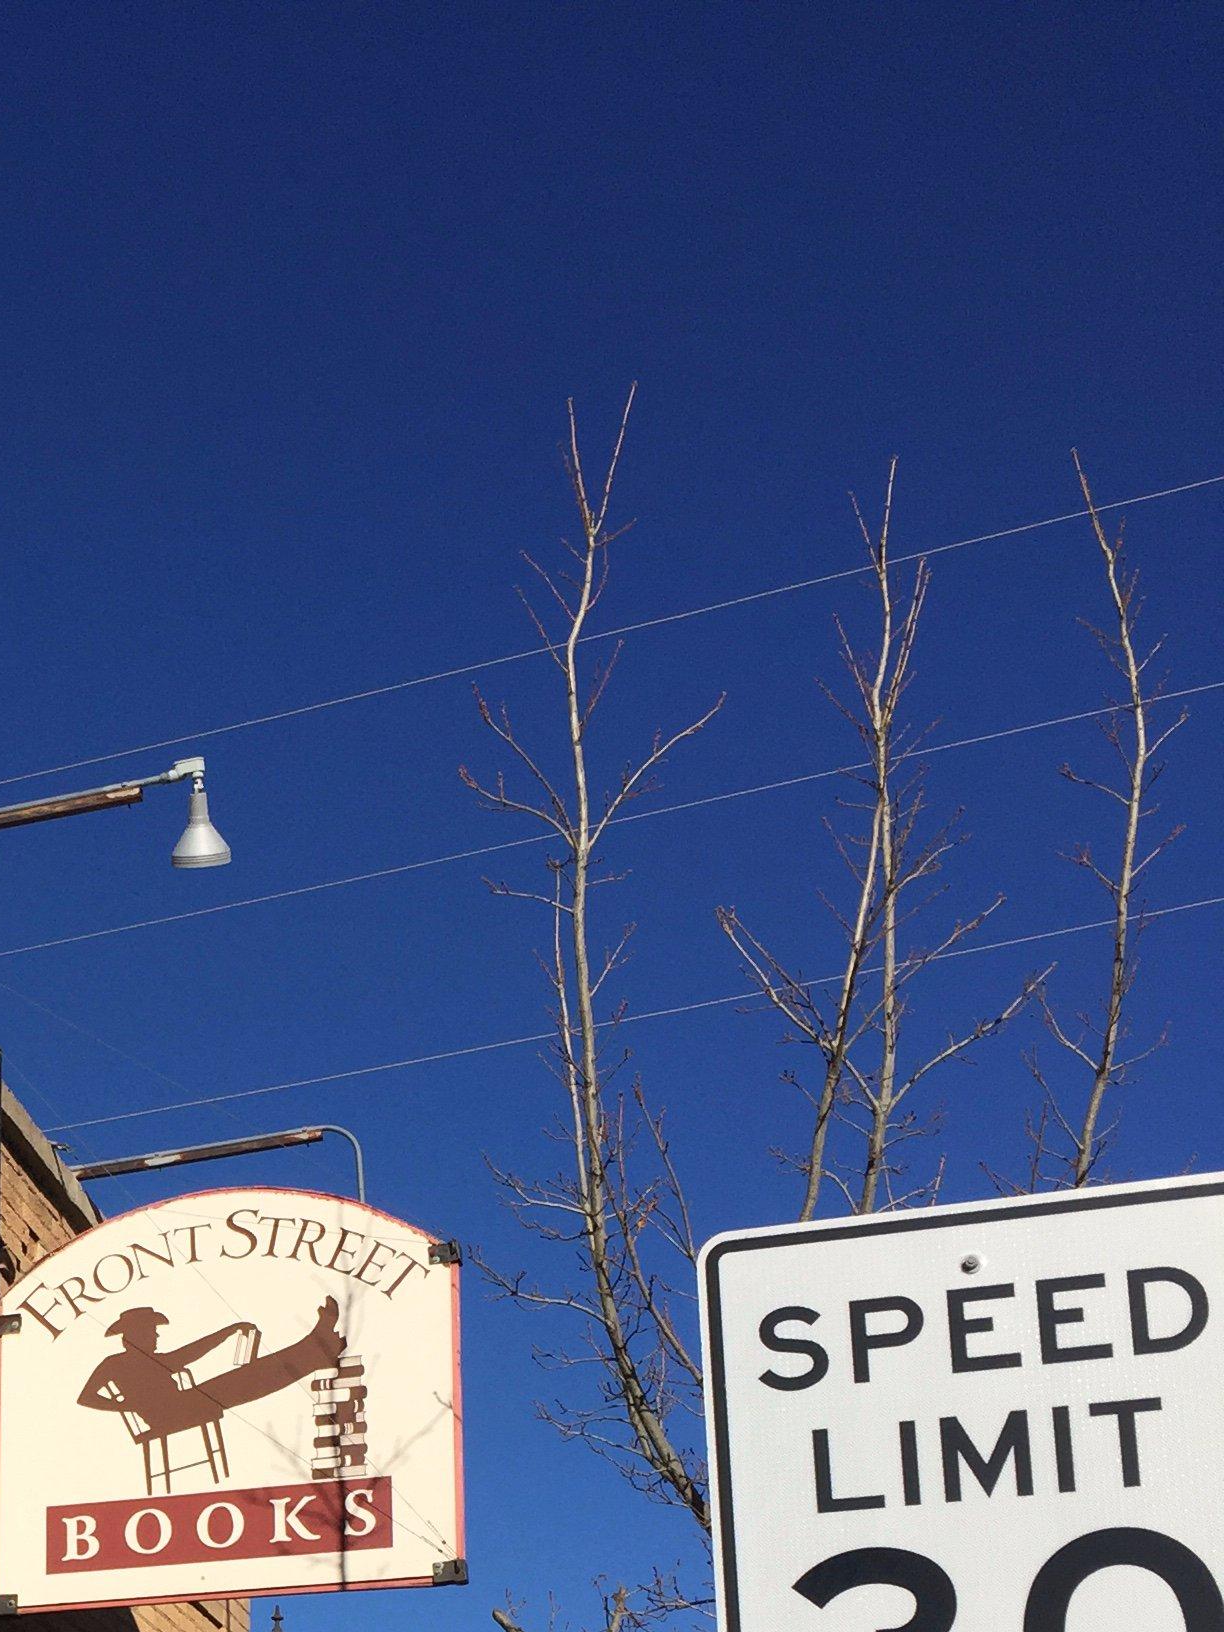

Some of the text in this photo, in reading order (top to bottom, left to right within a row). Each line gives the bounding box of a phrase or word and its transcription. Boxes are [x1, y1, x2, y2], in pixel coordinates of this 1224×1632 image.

[17, 1207, 430, 1342] FRONT STREET
[758, 1266, 1209, 1391] SPEED
[811, 1397, 1162, 1513] LIMIT
[61, 1489, 377, 1562] BOOKS
